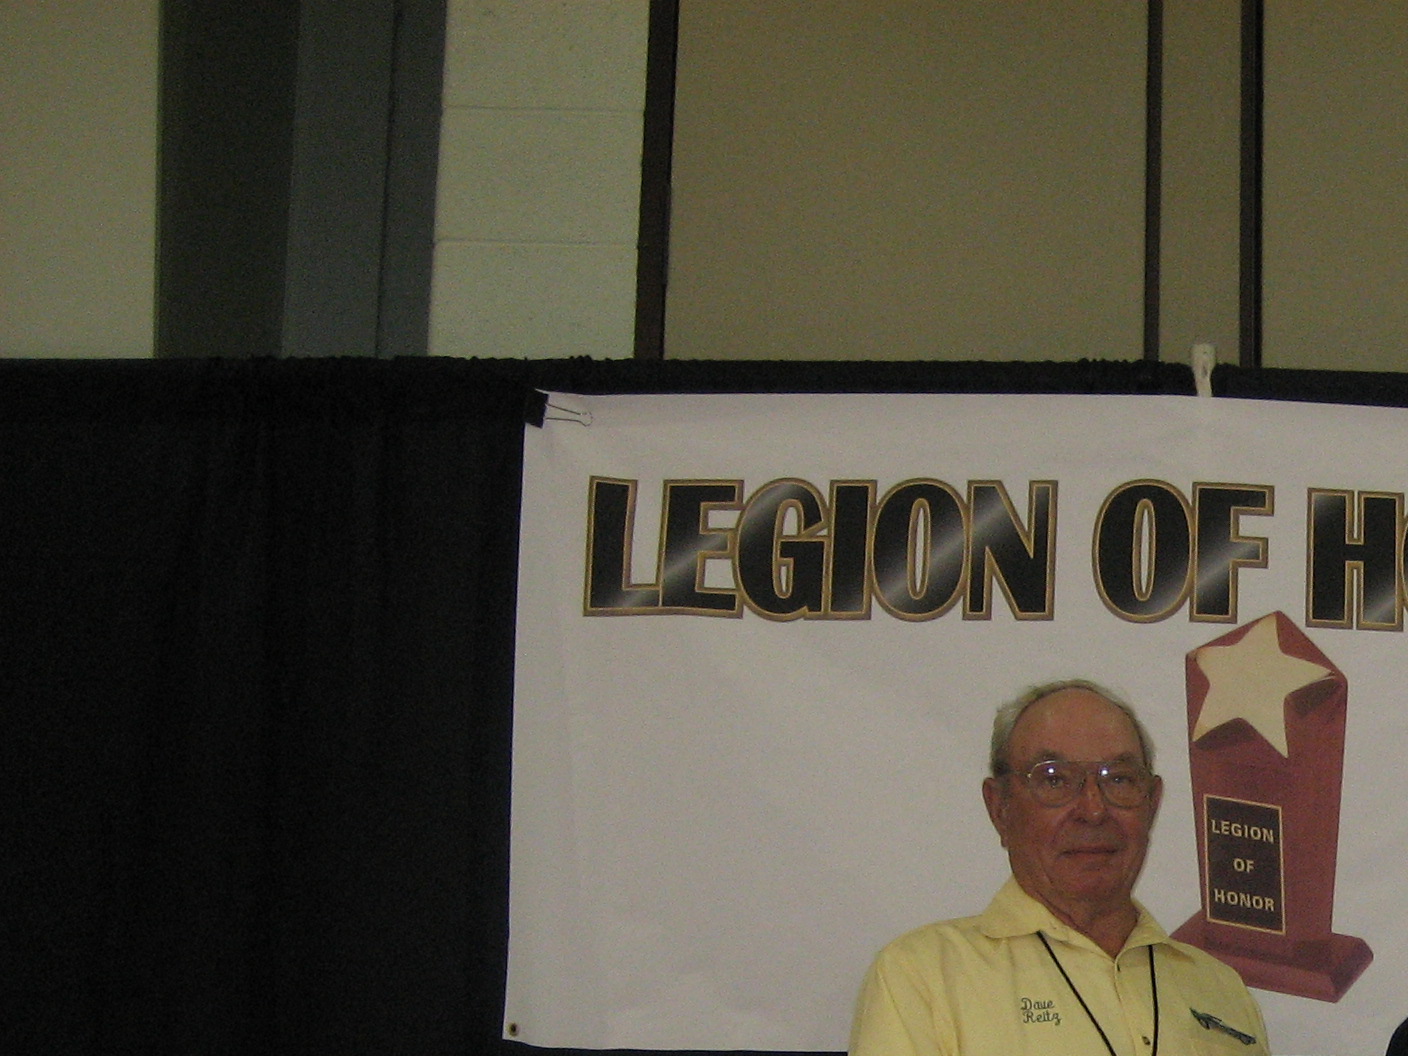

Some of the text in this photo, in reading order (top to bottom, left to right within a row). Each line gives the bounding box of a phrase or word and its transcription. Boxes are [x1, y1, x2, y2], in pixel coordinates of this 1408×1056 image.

[583, 475, 1058, 622] LEGION
[1092, 478, 1275, 624] OF
[1211, 819, 1274, 844] LEGION
[1233, 858, 1254, 873] OF
[1214, 888, 1275, 912] HONOR
[1020, 997, 1055, 1010] Dave
[1022, 1010, 1062, 1026] Reitz
